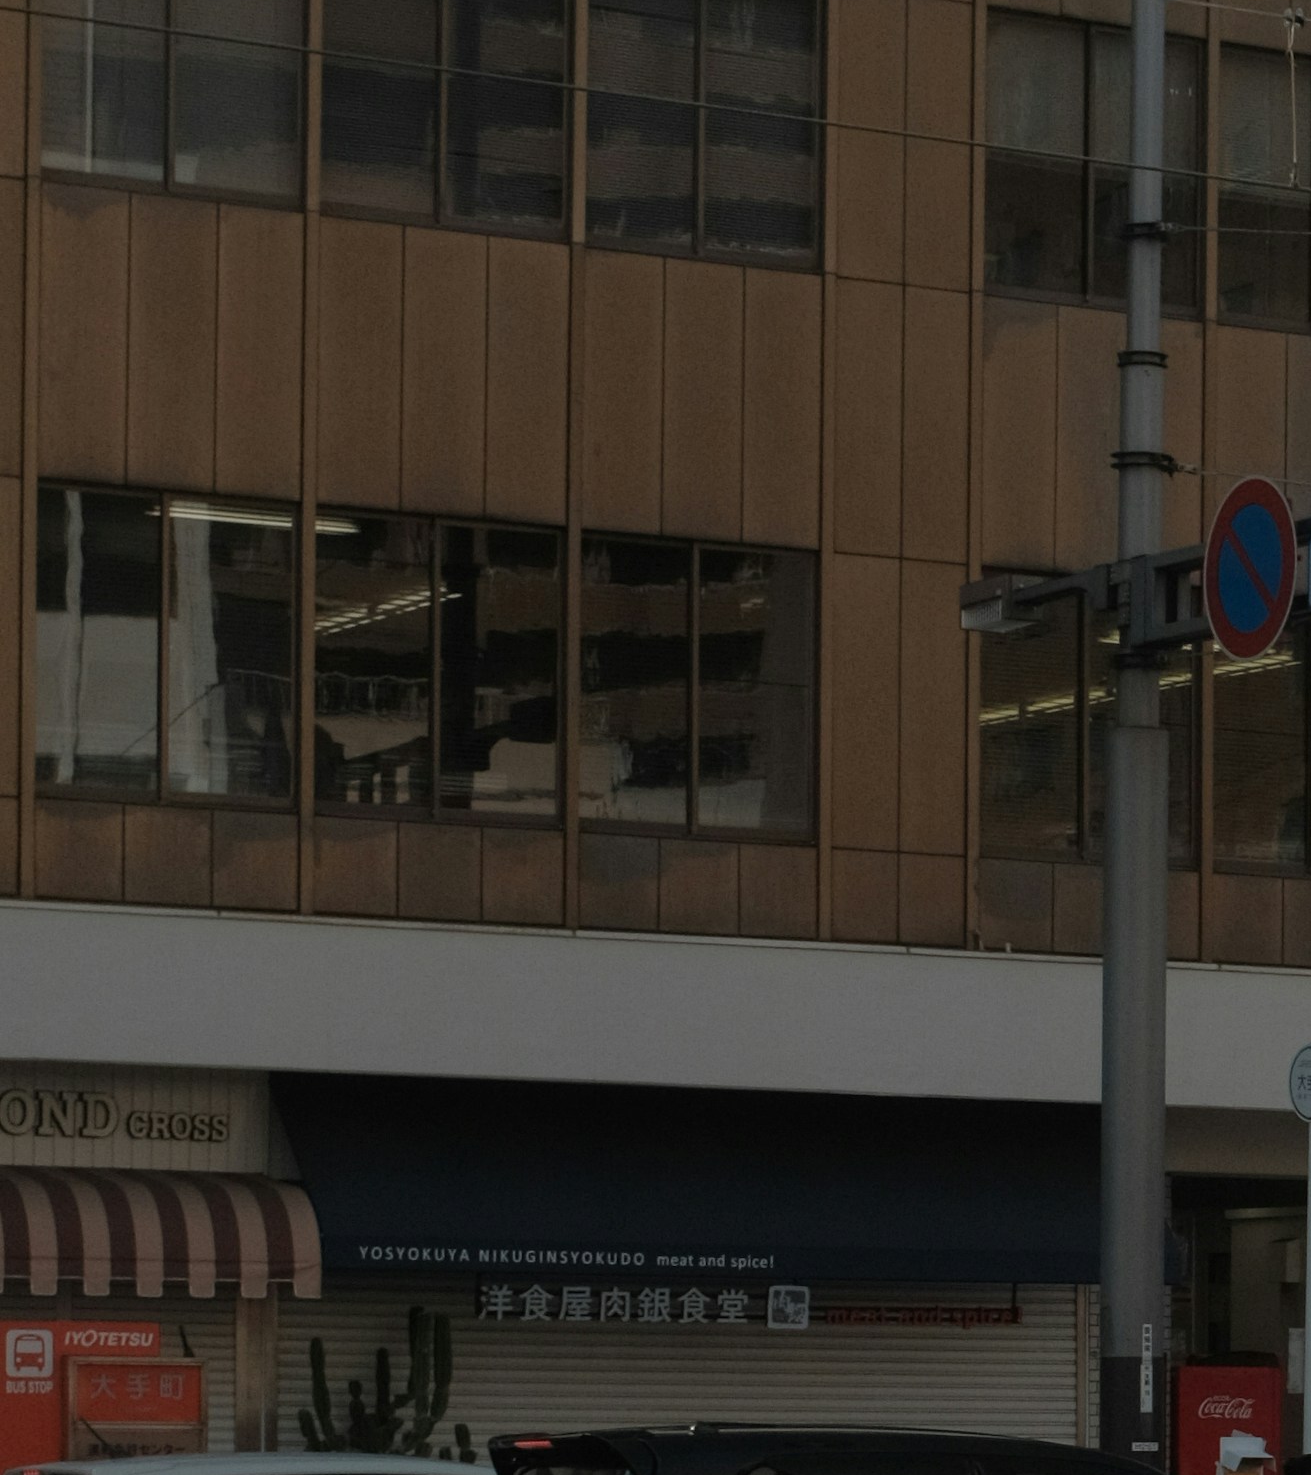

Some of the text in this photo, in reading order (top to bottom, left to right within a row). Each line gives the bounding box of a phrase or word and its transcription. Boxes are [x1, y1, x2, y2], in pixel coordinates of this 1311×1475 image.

[0, 1089, 230, 1142] OND CROSS
[359, 1246, 775, 1270] YOSYOKUYA NIKUGINSYOKUDO meat and spice!
[478, 1285, 750, 1324] 洋食屋肉銀食堂
[64, 1329, 153, 1347] IYOTETSU
[6, 1381, 53, 1394] BUS STOP
[90, 1374, 186, 1400] 大手町
